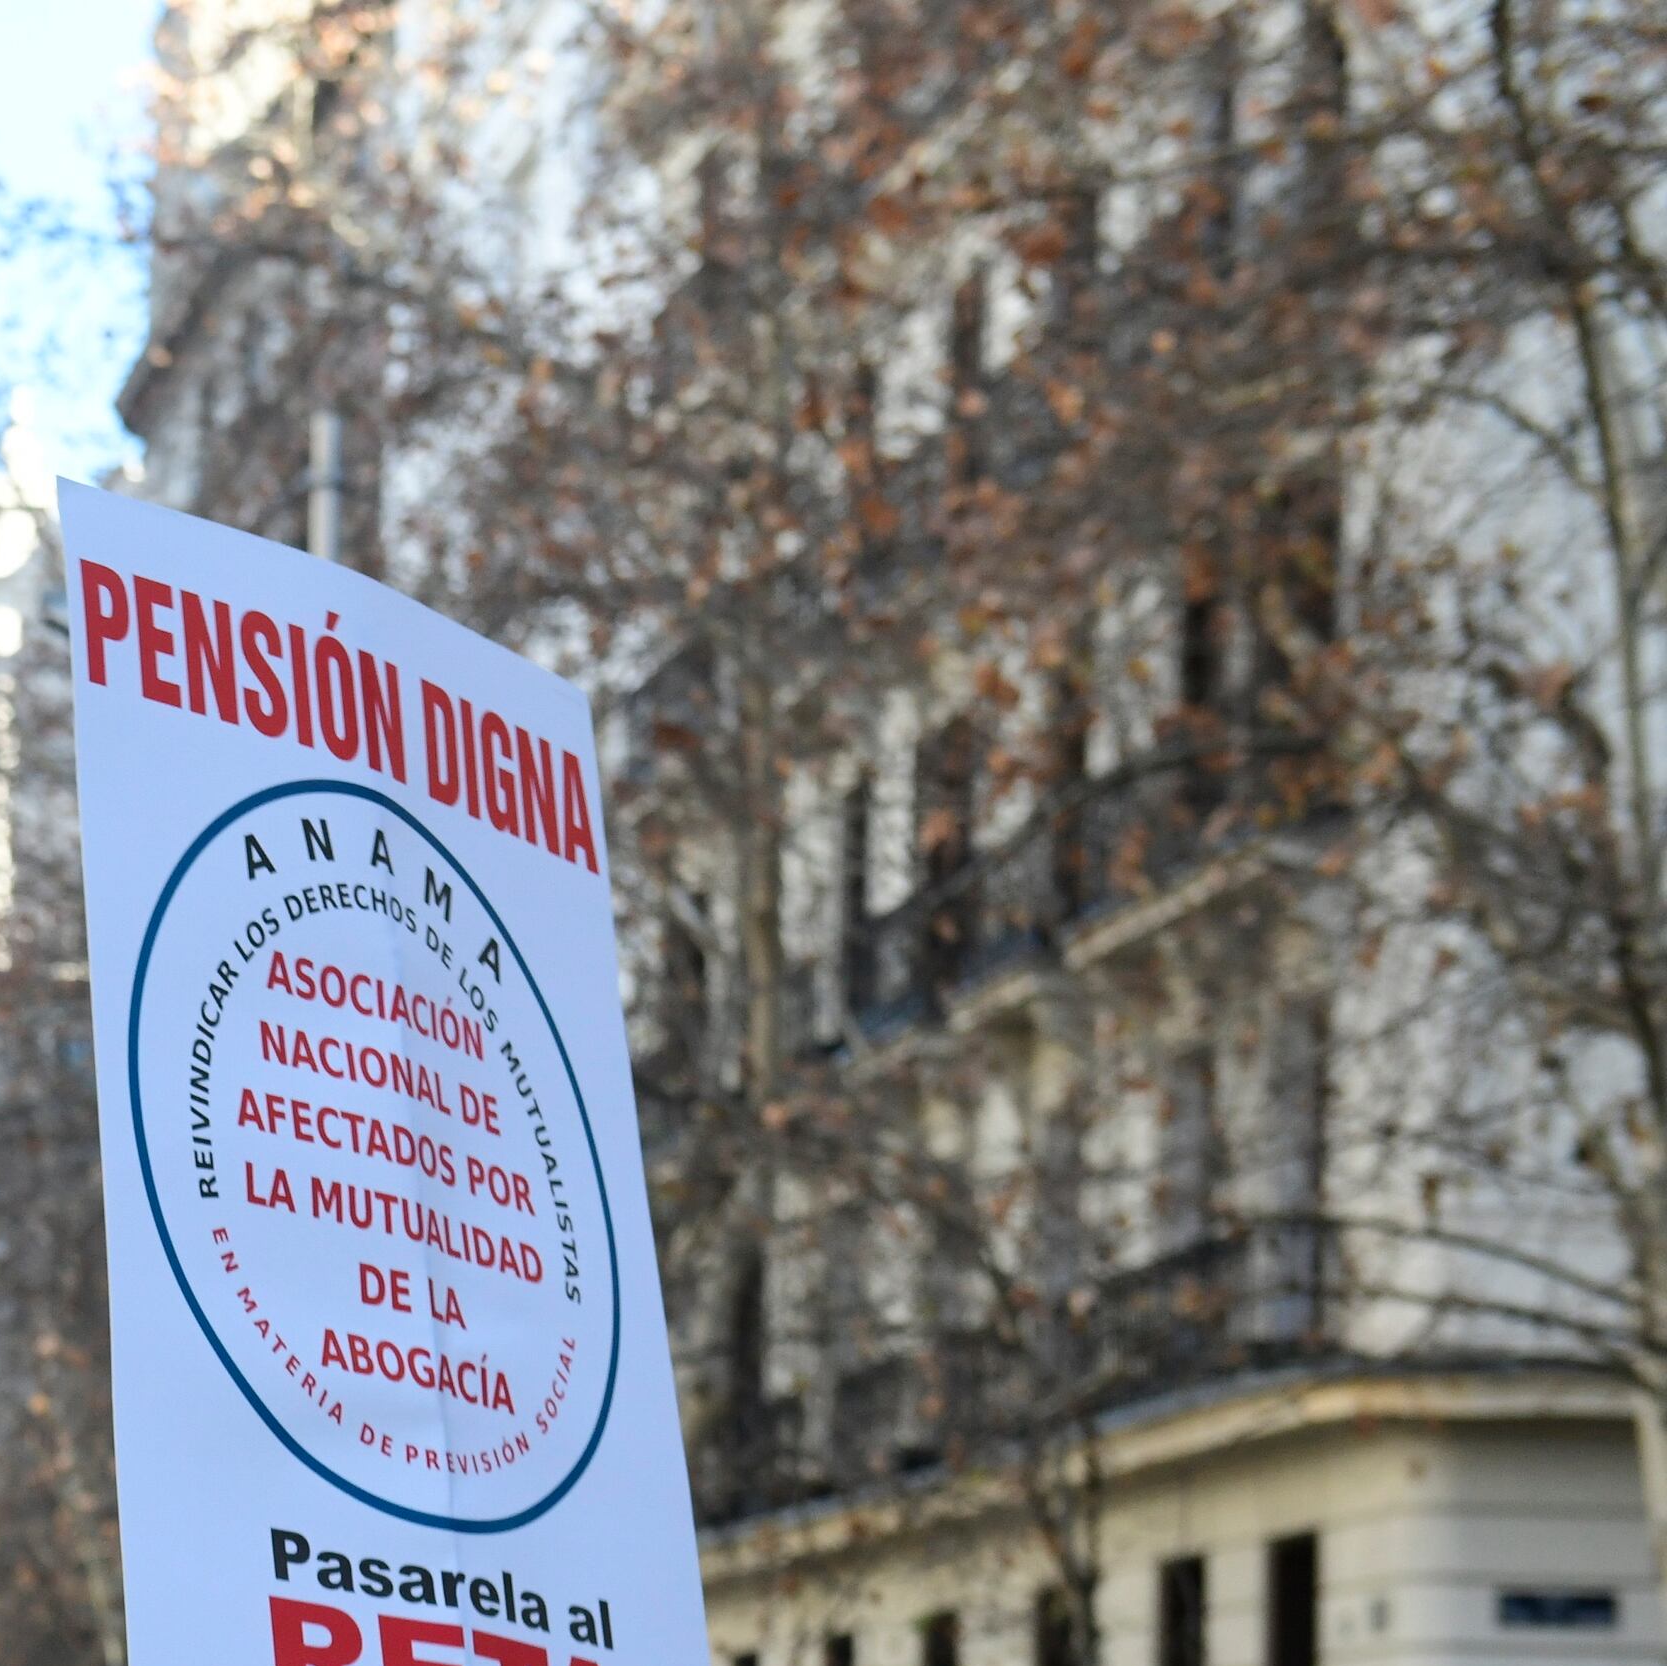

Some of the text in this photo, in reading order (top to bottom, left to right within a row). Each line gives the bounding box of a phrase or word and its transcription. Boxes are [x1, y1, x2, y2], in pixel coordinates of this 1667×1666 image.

[80, 560, 600, 874] PENSIÓN DIGNA
[267, 951, 484, 1061] ASOCIACIÓN
[190, 883, 581, 1302] REIVINDICAR LOS DERECHOS DE LOS MUTUALISTAS
[259, 1020, 500, 1136] NACIONAL DE
[238, 1088, 535, 1215] AFECTADOS POR
[245, 1162, 543, 1284] LA MUTUALIDAD
[213, 1228, 575, 1472] EN MATERIA DE PREVISIÓN SOCIAL
[359, 1263, 467, 1328] DE LA
[321, 1328, 516, 1414] ABOGACÍA
[271, 1527, 614, 1651] Pasarela al
